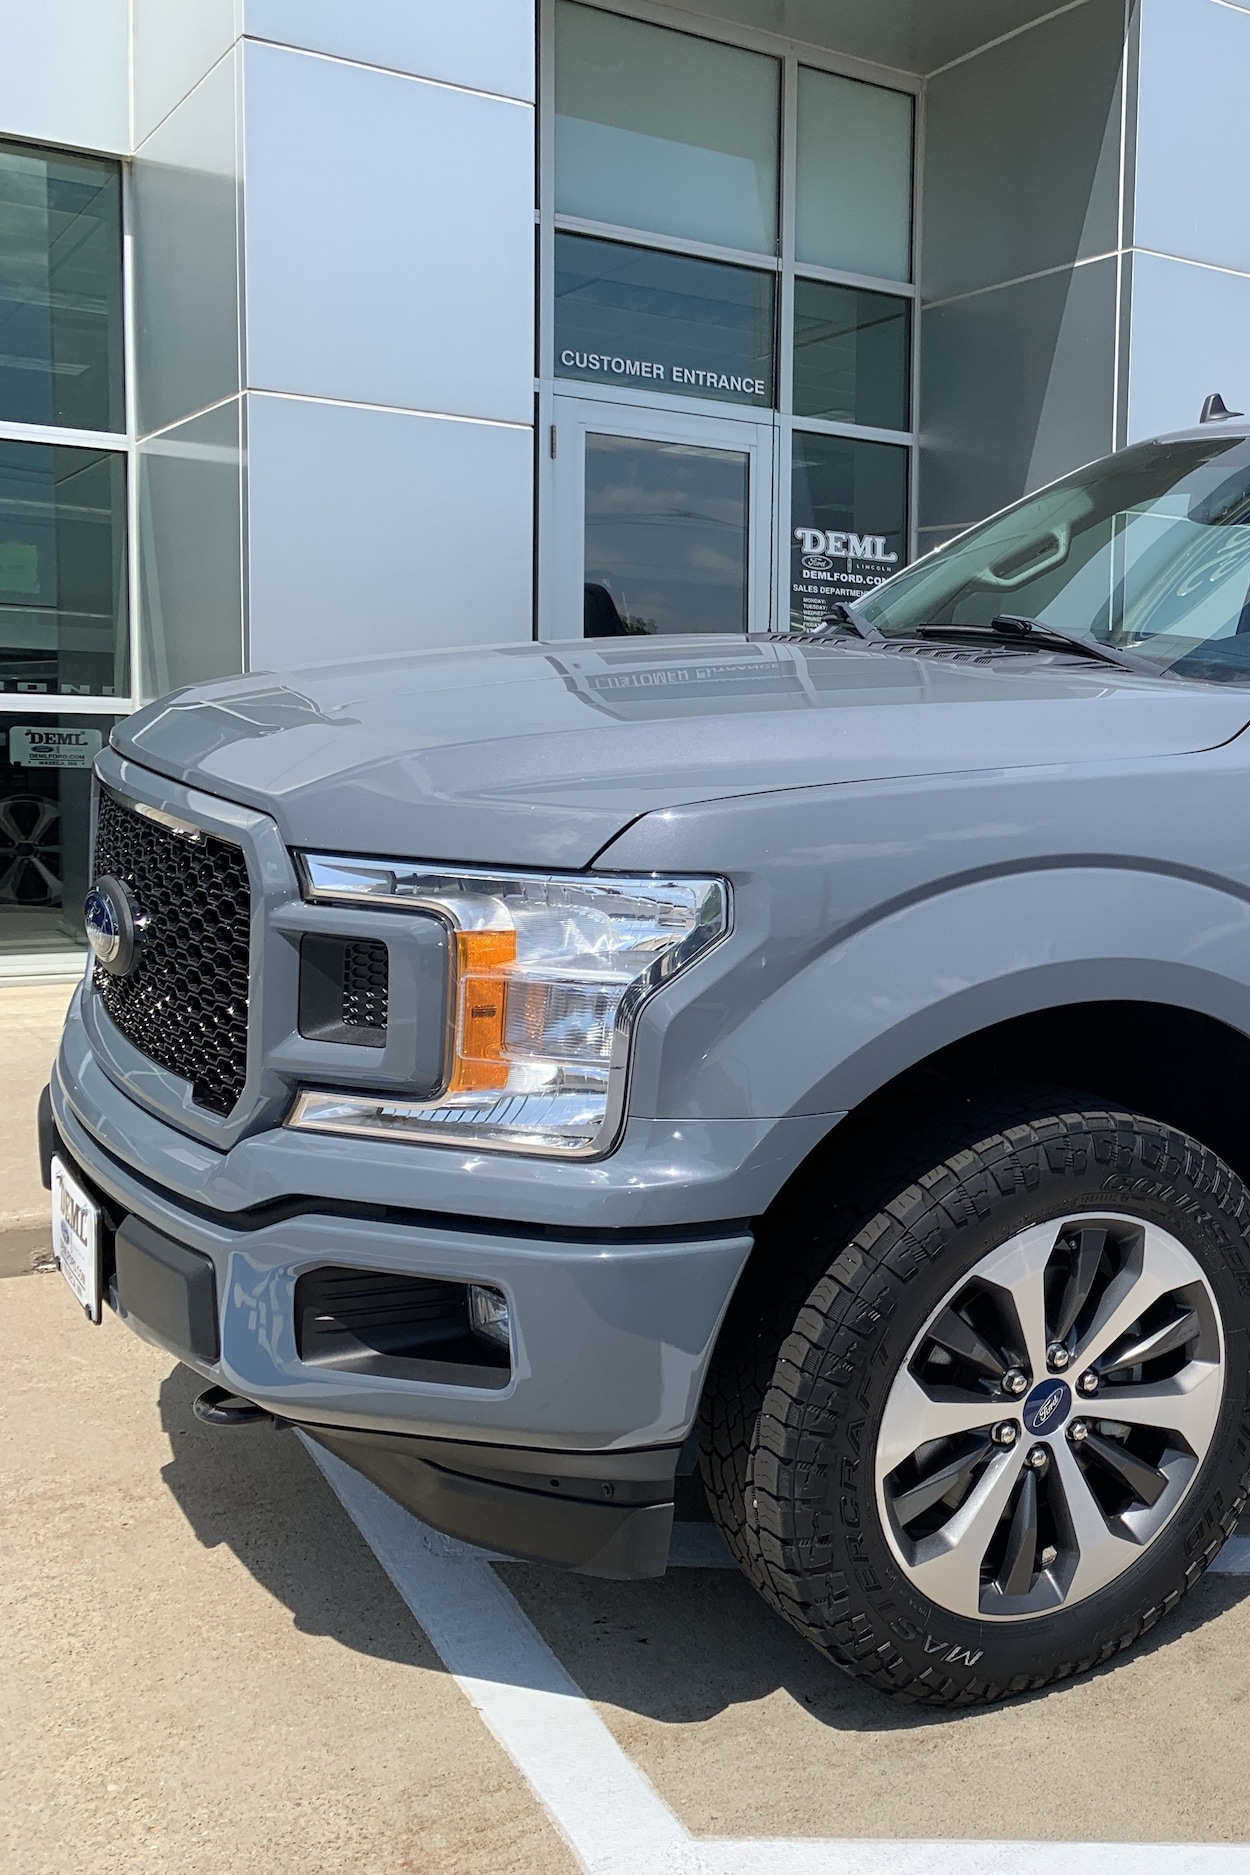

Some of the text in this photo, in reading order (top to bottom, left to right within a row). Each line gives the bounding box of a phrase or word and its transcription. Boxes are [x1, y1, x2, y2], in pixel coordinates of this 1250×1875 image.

[561, 350, 765, 395] CUSTOMER ENTRANCE
[794, 527, 898, 563] DEML
[856, 563, 892, 571] LINCOLN
[792, 584, 869, 598] SALES DEPARTMEN
[25, 731, 88, 746] DEML
[838, 1325, 984, 1668] MASTERCRAFT
